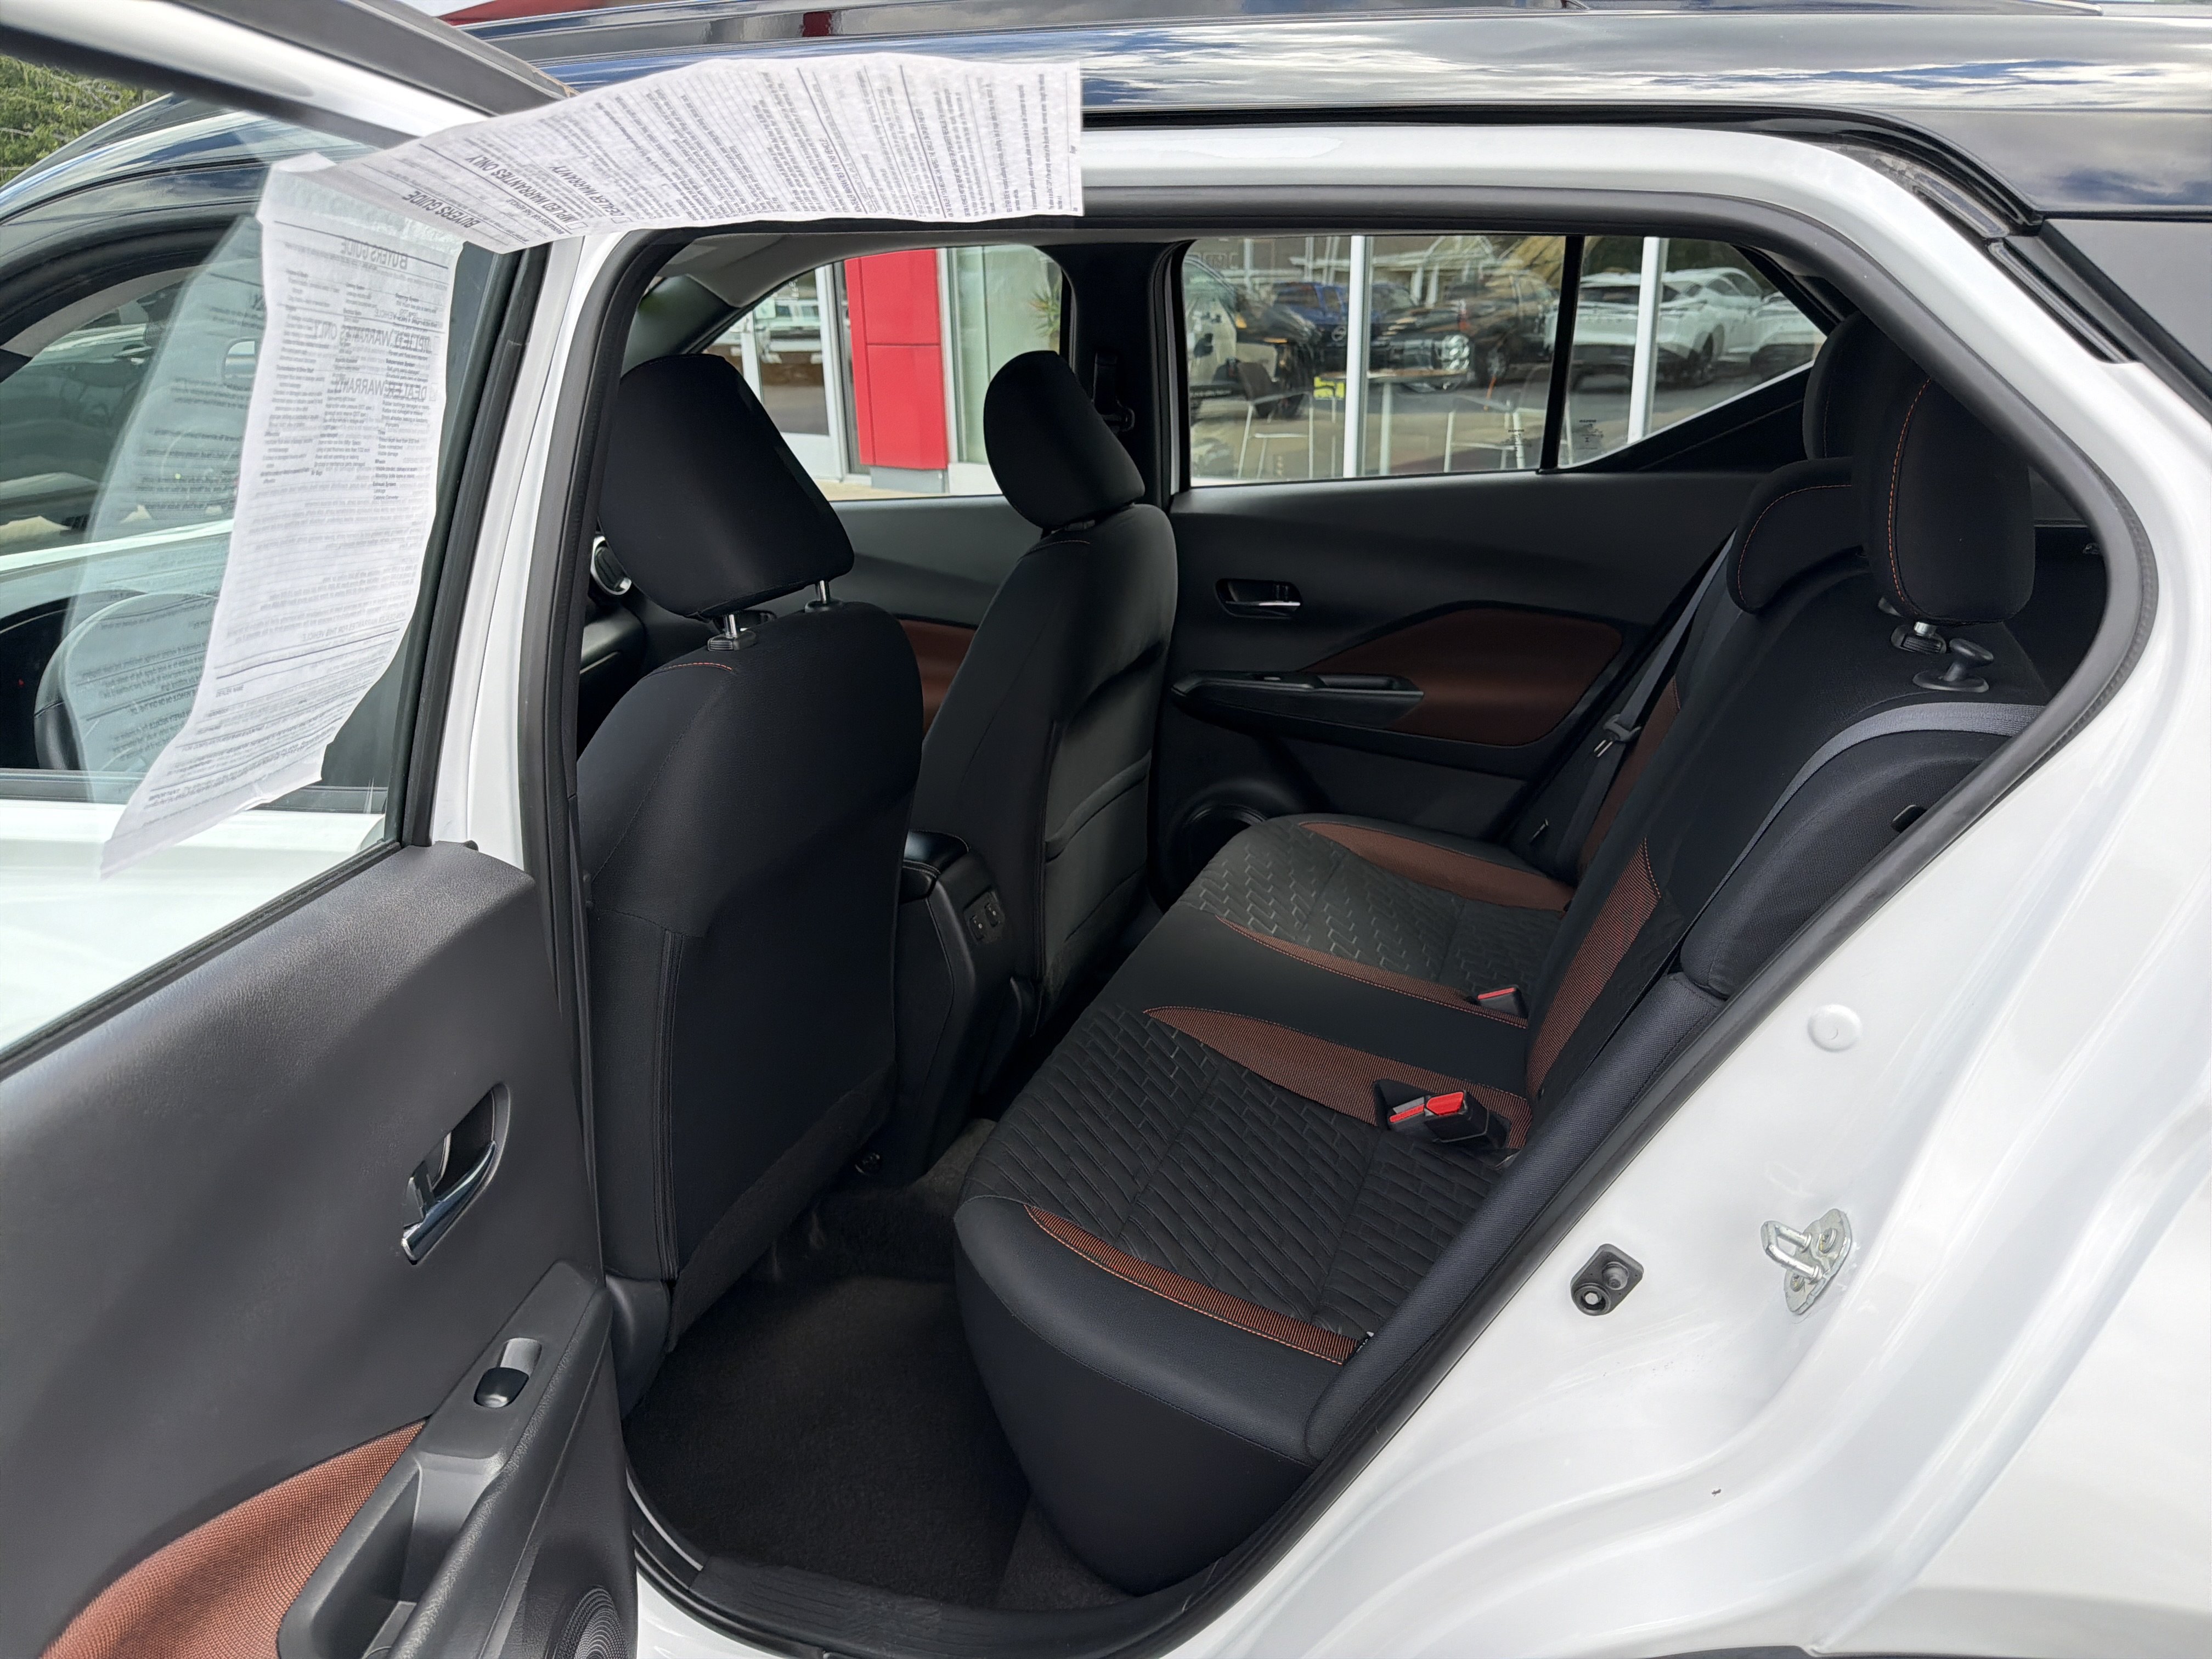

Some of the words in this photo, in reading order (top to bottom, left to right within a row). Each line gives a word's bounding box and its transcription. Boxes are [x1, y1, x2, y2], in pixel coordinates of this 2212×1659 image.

[465, 155, 500, 172] ONLY
[491, 168, 550, 205] WARRANTIES
[548, 165, 601, 196] WARRANTY
[402, 190, 439, 212] GUIDE
[541, 201, 579, 224] IMPLIED
[589, 195, 625, 217] DEALER
[435, 206, 482, 229] BUYERS
